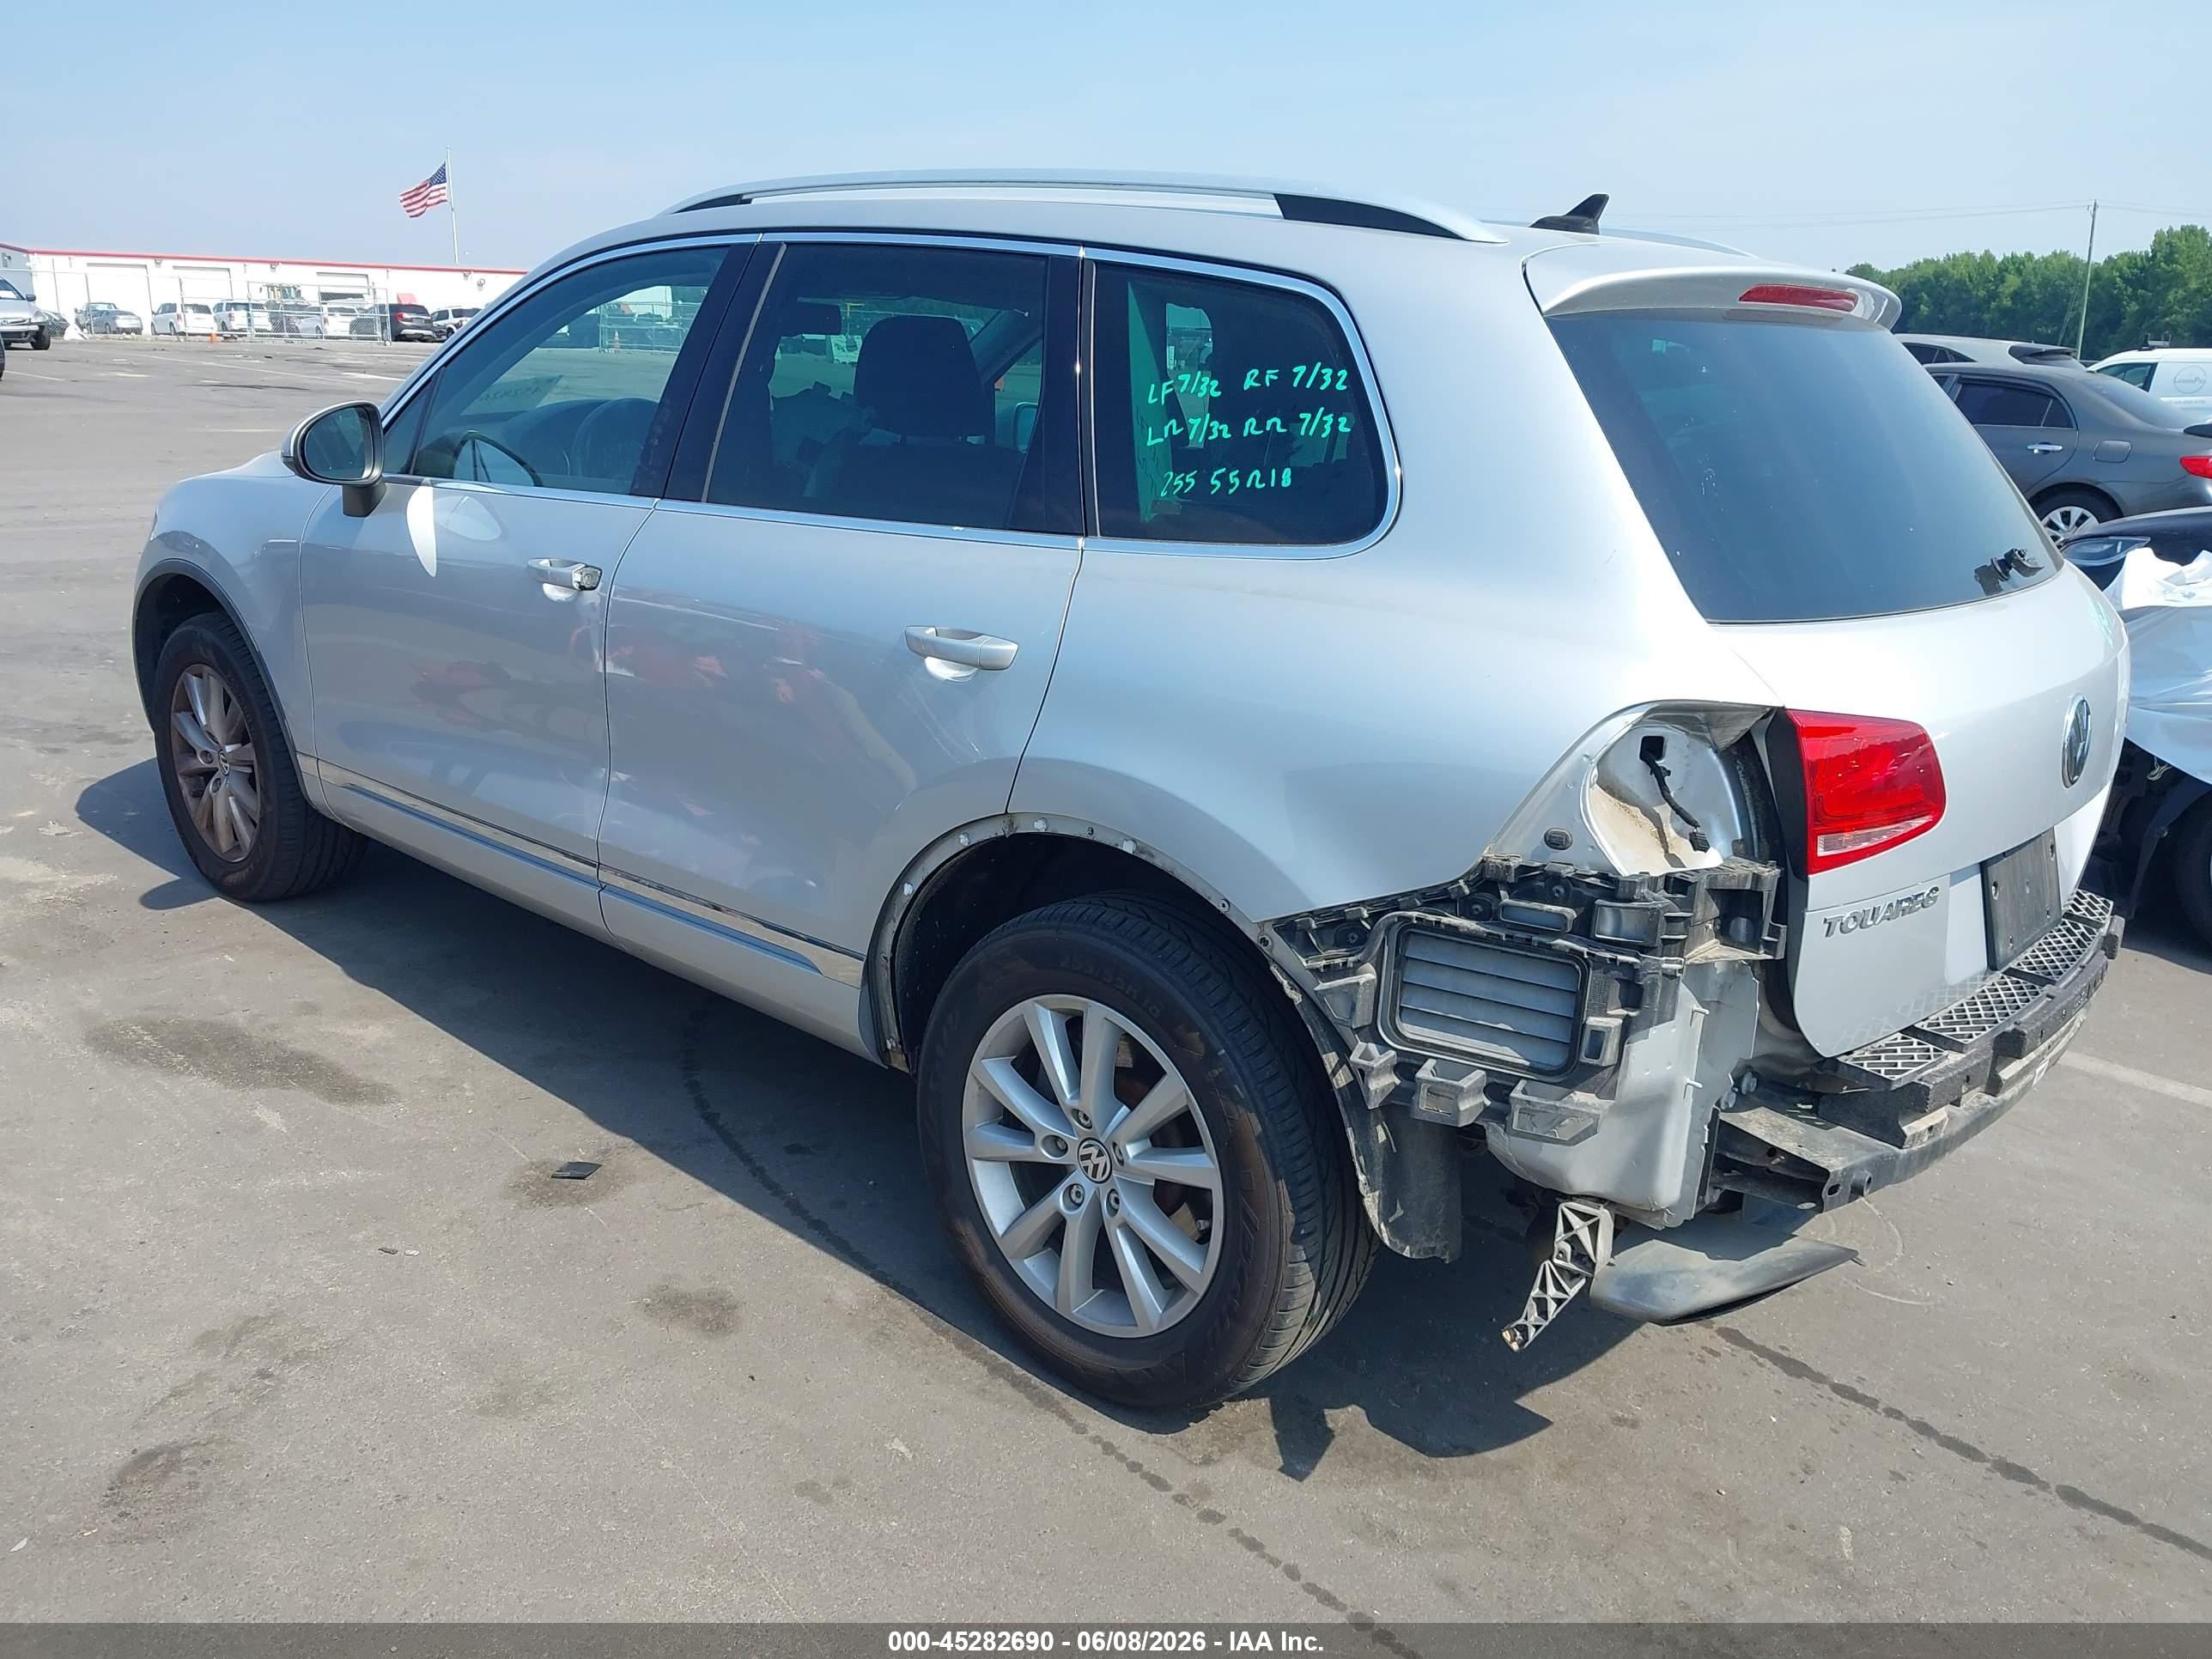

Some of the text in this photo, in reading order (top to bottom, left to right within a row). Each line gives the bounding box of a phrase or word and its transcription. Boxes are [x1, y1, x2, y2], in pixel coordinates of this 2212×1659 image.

[1148, 362, 1348, 405] LF 7/32 RF 7/32
[1188, 413, 1232, 443] 7/32
[1299, 406, 1352, 438] 7/32
[1823, 885, 1940, 938] TOUAREG
